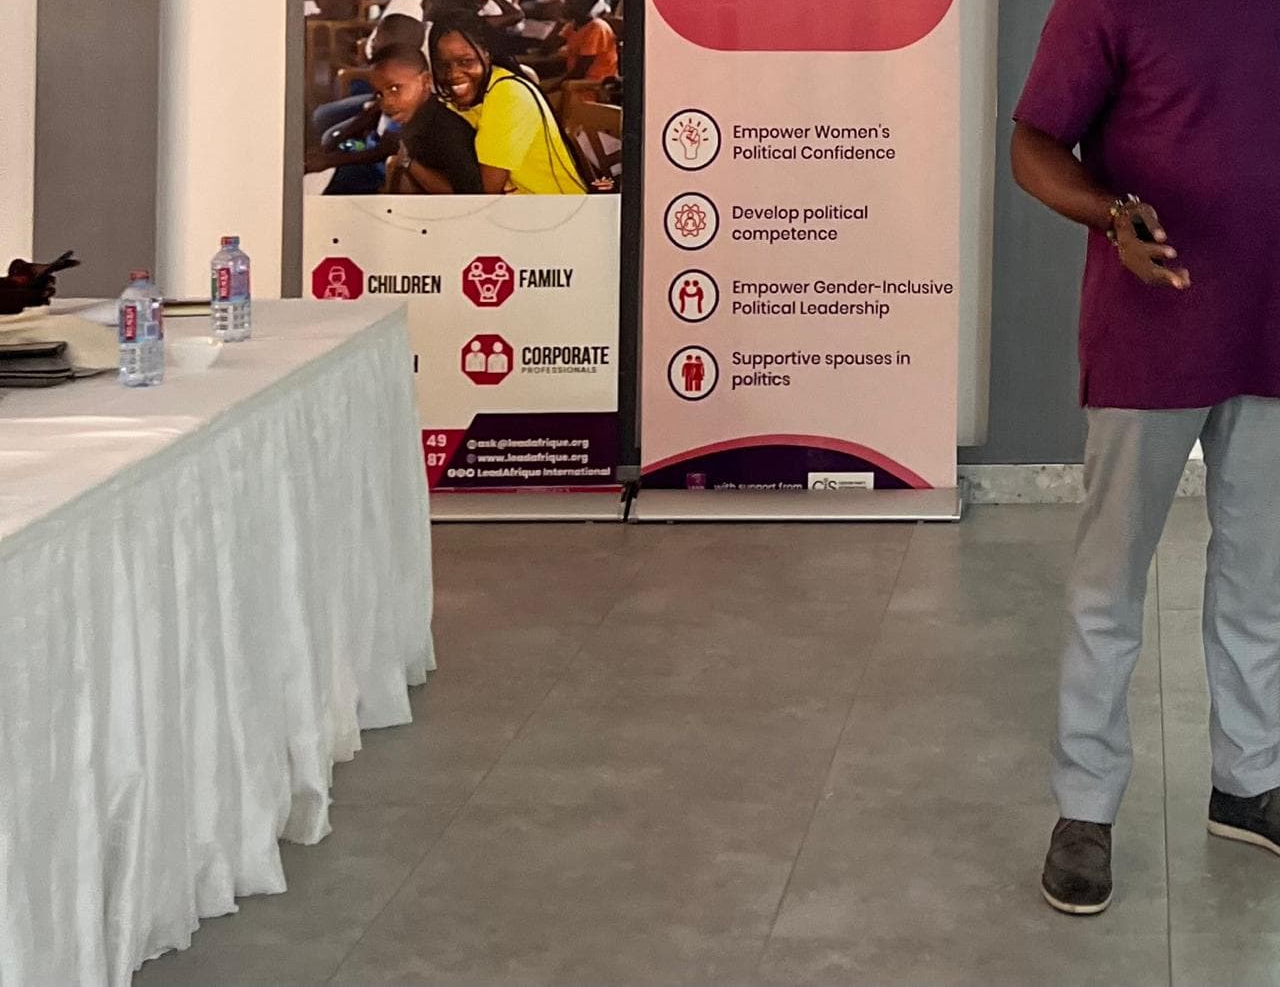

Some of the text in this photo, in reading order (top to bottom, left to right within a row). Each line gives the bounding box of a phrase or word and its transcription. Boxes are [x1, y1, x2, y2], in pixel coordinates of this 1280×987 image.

[733, 123, 890, 142] Empower Women's
[733, 145, 896, 160] Political Confidence
[732, 205, 869, 223] Develop political
[732, 229, 838, 244] competence
[368, 275, 441, 294] CHILDREN
[519, 269, 573, 288] FAMILY
[732, 280, 954, 298] Empower Gender-Inclusive
[732, 301, 890, 319] Political Leadership
[522, 346, 610, 364] CORPORATE
[732, 350, 911, 369] Supportive spouses in
[521, 366, 597, 374] PROFESSIONALS
[732, 372, 791, 390] politics
[426, 434, 447, 447] 49
[427, 453, 447, 467] 87
[543, 467, 611, 476] International
